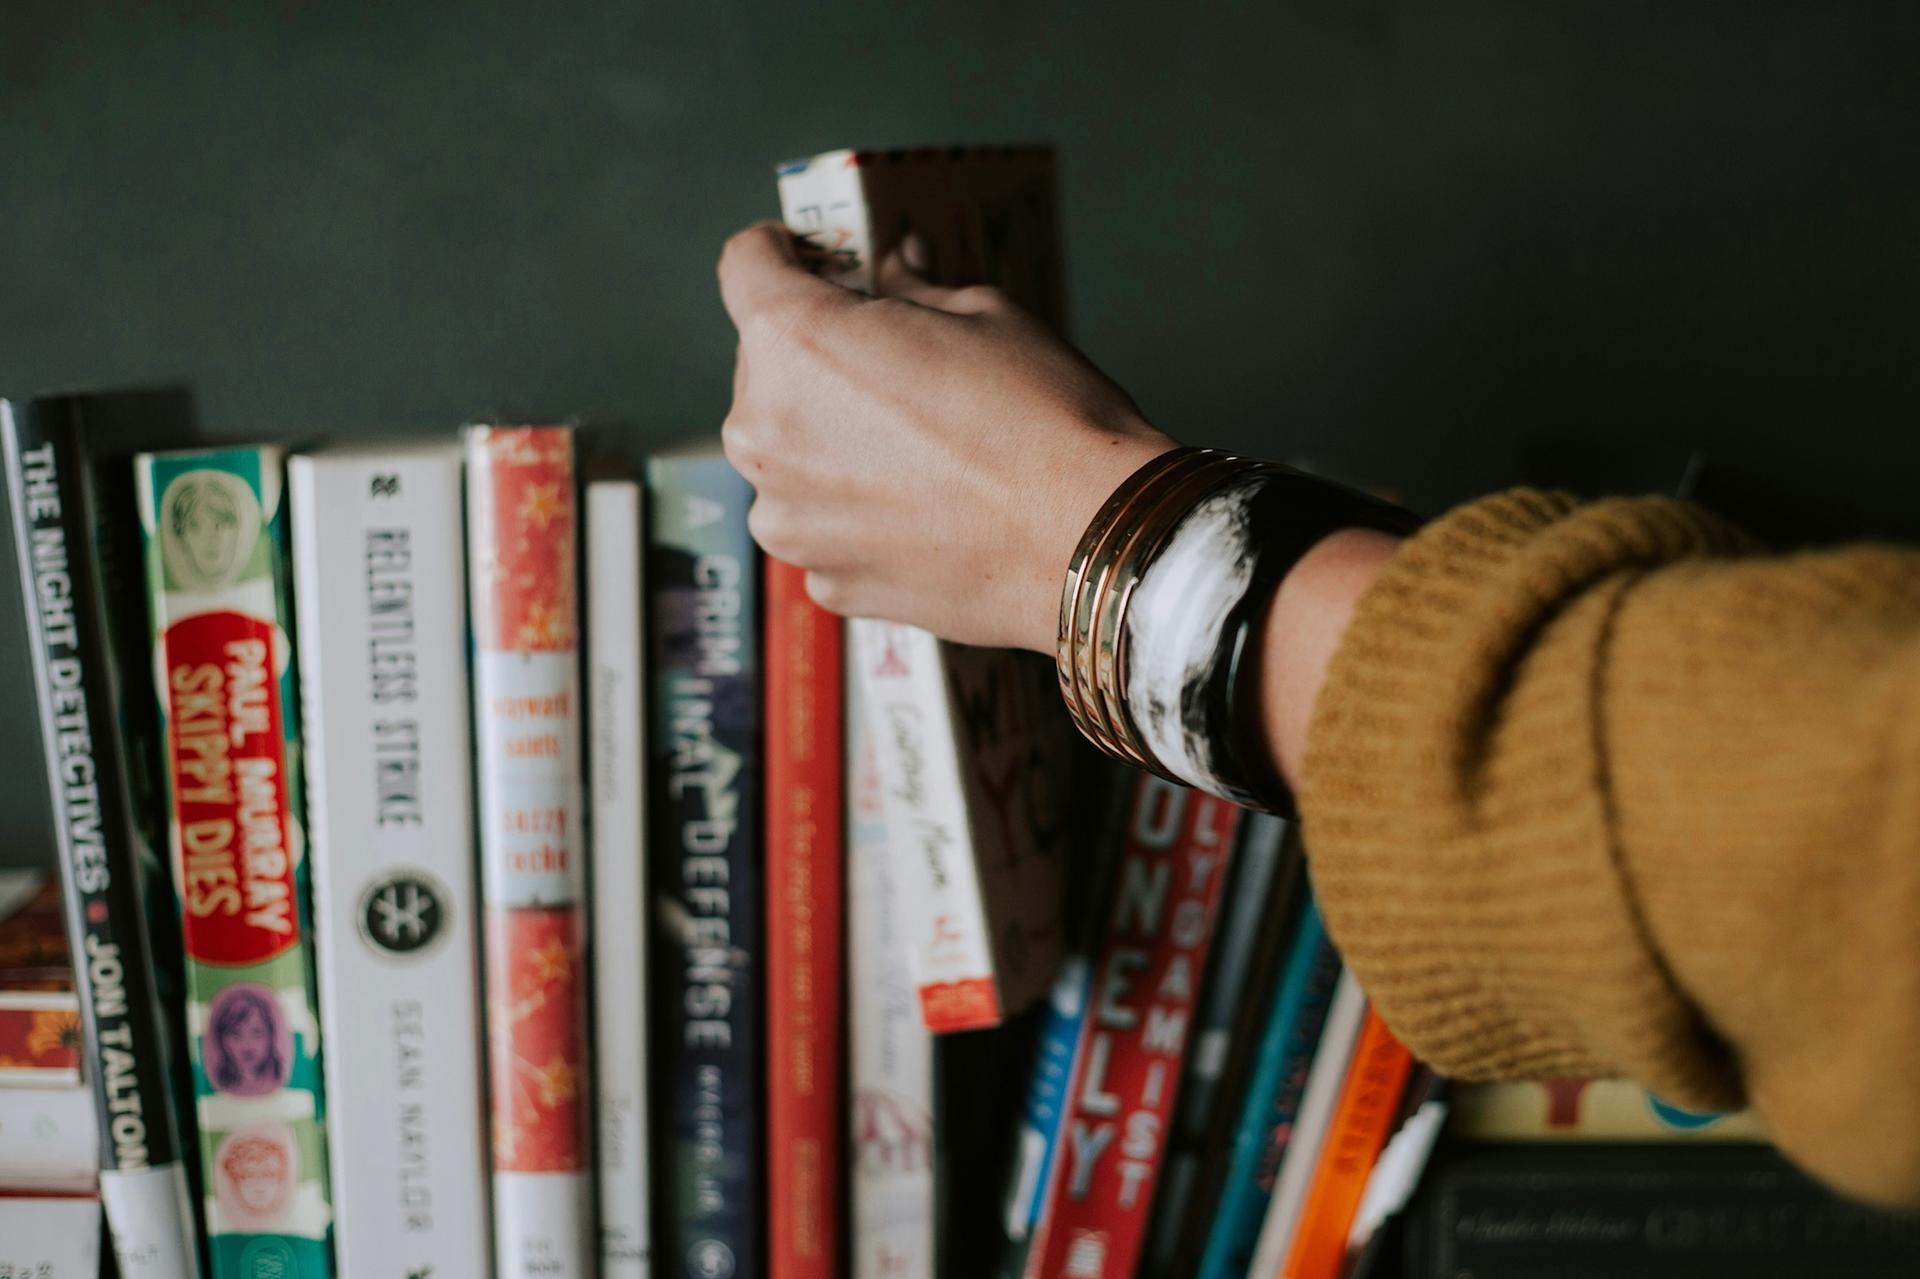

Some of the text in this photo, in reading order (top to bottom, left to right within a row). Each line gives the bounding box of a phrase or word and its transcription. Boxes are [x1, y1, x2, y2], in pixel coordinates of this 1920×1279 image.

[22, 440, 151, 1171] THE NIGHT DETECTIVES JON TALTON
[172, 664, 242, 918] SKIPPY DIES
[224, 637, 292, 935] PAUL MURRAY
[366, 528, 422, 829] RELENTLESS STRIKE
[681, 820, 733, 1049] DEFENSE
[1067, 774, 1188, 1201] ONELY
[1116, 793, 1222, 1209] LYGAMIST
